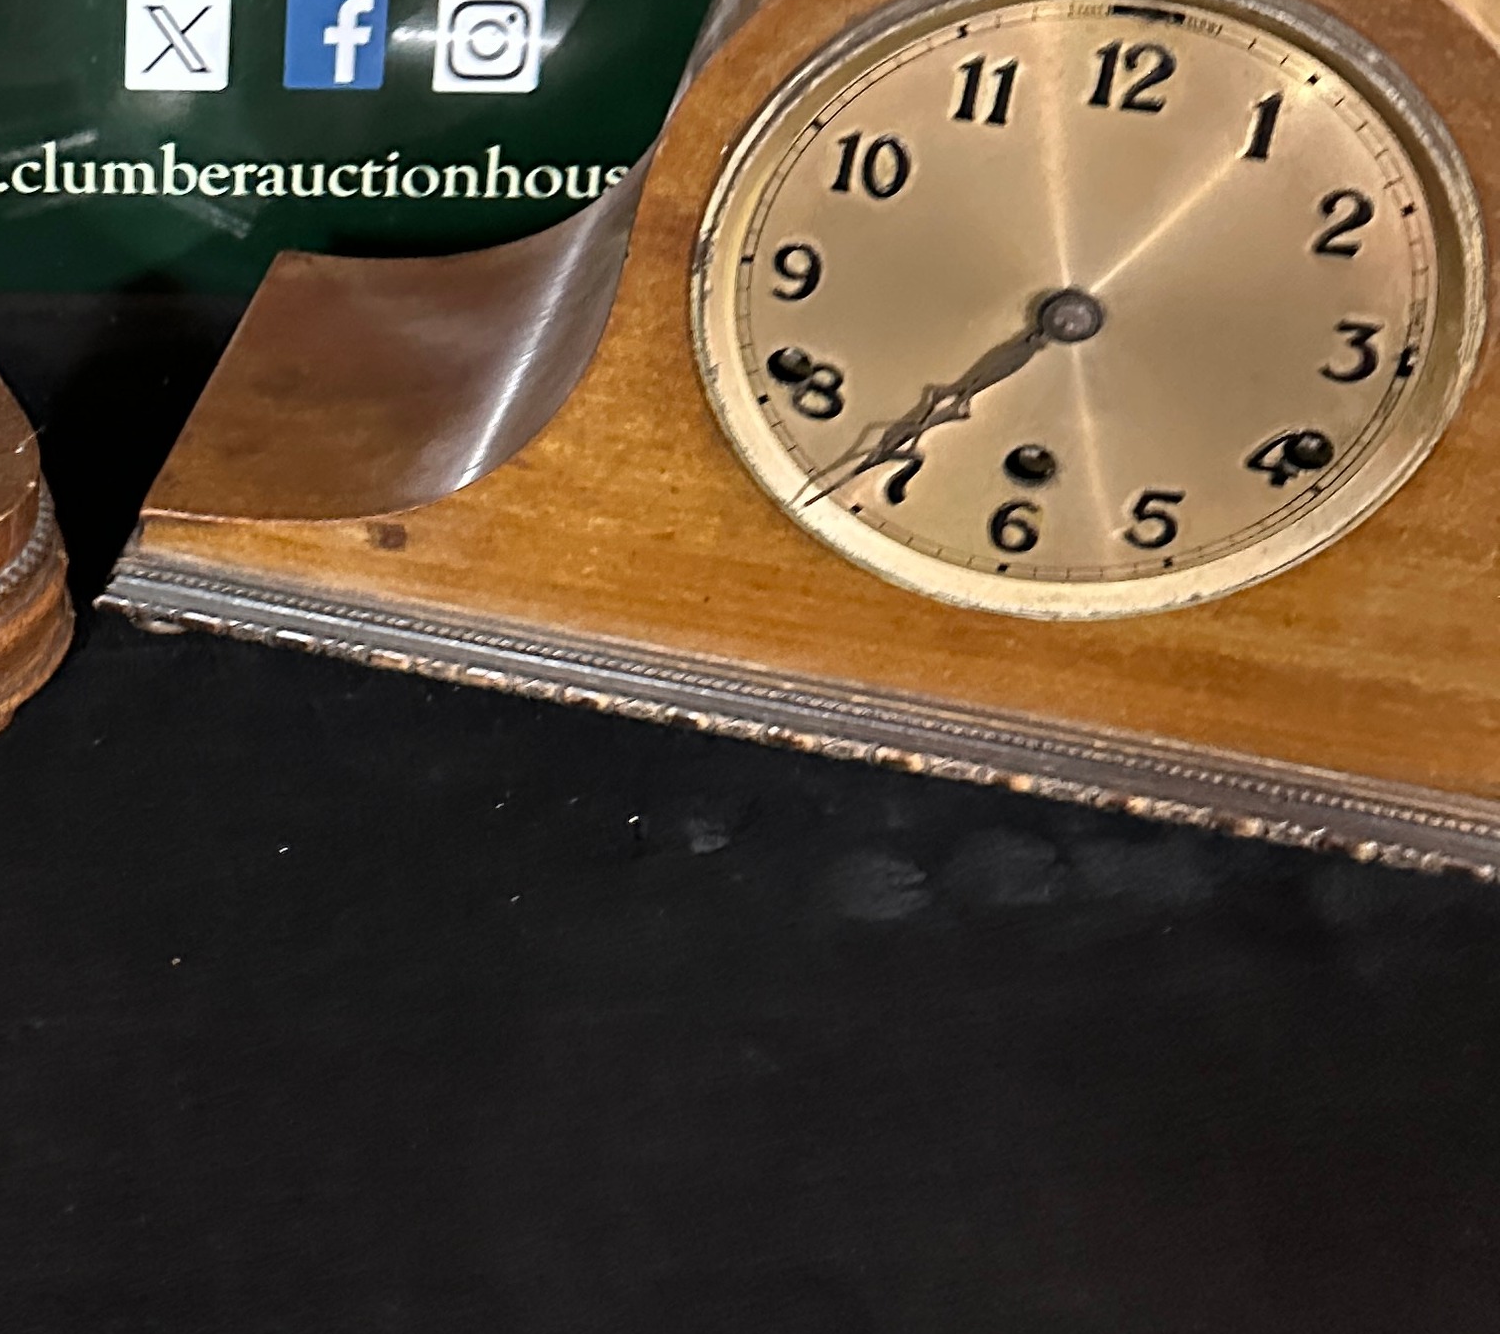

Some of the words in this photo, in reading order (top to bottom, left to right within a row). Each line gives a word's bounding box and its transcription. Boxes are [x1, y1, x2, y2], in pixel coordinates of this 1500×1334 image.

[951, 54, 1019, 127] 11
[1087, 40, 1178, 114] 12
[1239, 91, 1281, 162] 1
[830, 132, 913, 201] 10
[1312, 188, 1374, 259] 2
[772, 241, 822, 302] 9
[1320, 320, 1384, 383] 3
[792, 362, 845, 420] 8
[989, 499, 1040, 553] 6
[1124, 489, 1186, 550] 5
